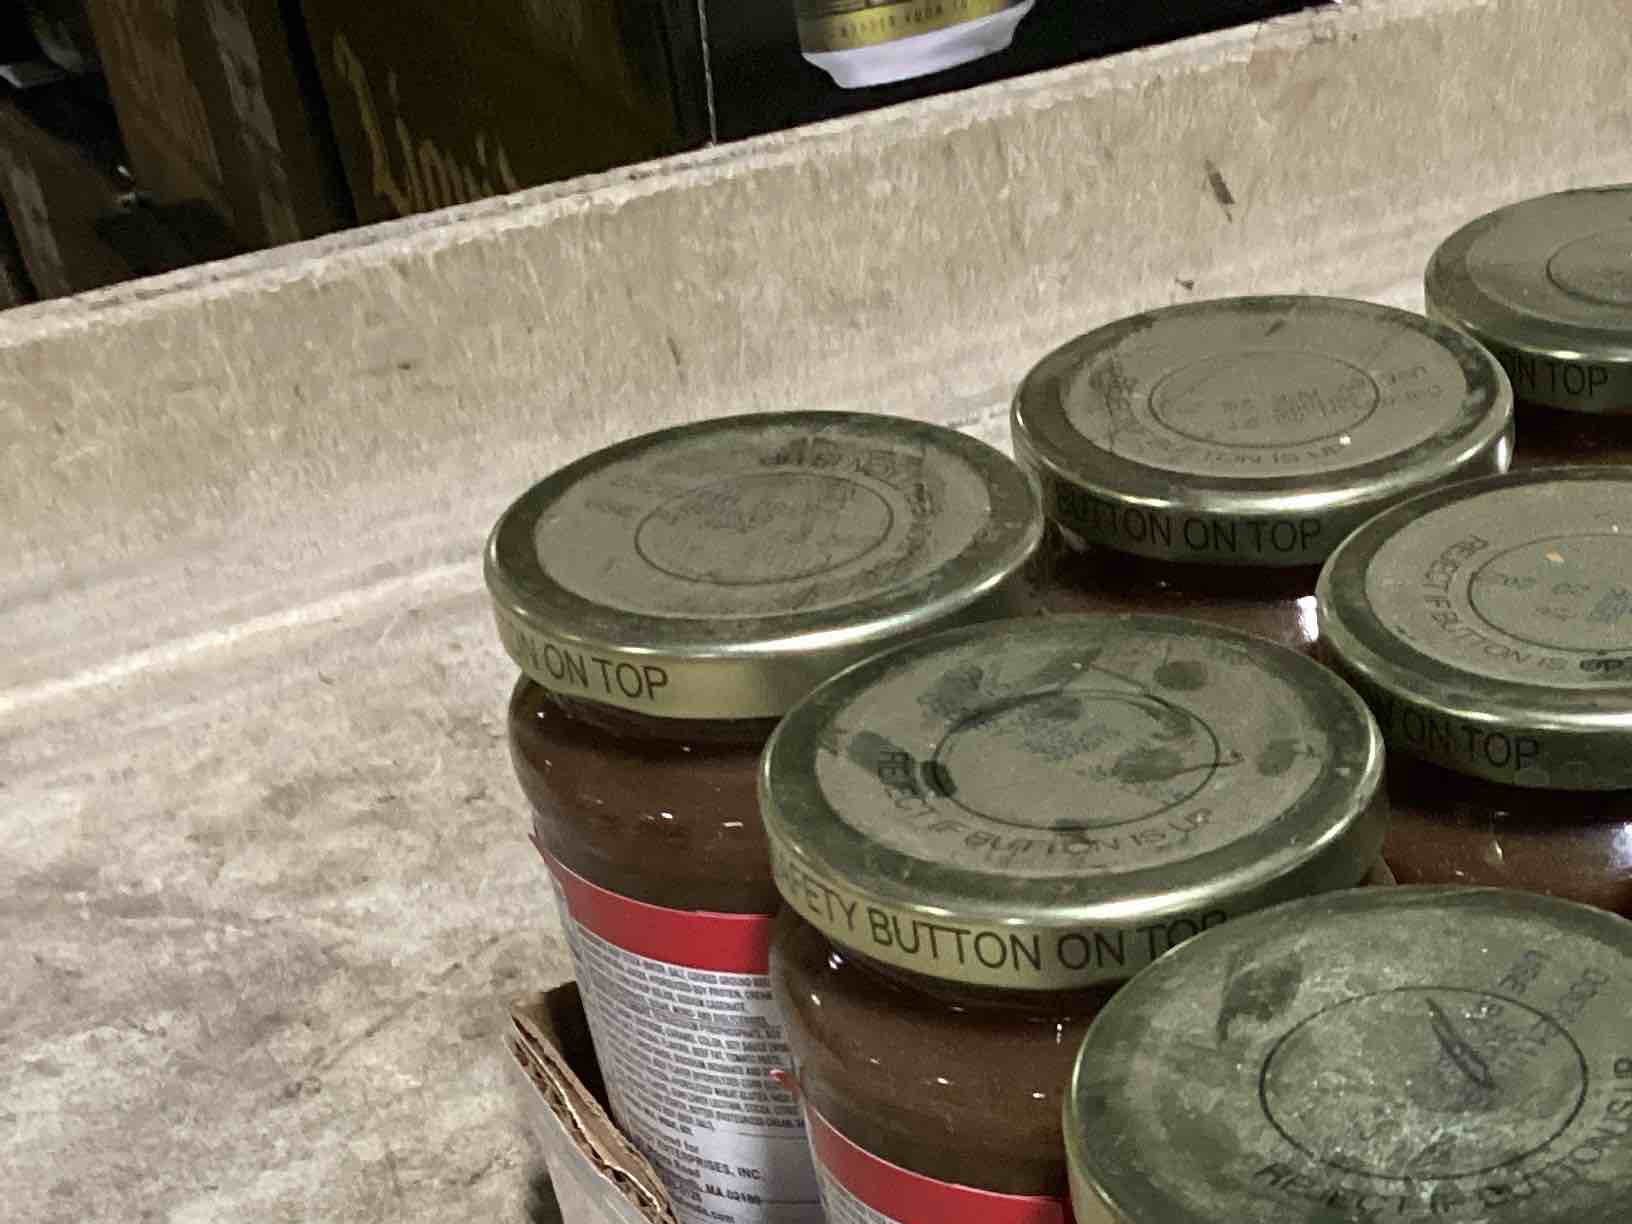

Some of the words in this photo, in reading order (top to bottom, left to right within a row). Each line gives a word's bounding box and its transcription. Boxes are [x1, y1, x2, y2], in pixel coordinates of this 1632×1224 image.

[1549, 364, 1608, 396] TOP
[1183, 518, 1238, 553] ON
[1247, 517, 1322, 552] TOP
[544, 643, 589, 689] ON
[591, 656, 669, 700] TOP
[1461, 723, 1541, 771] TOP
[866, 905, 1043, 971] BUTTON
[1057, 931, 1126, 971] ON
